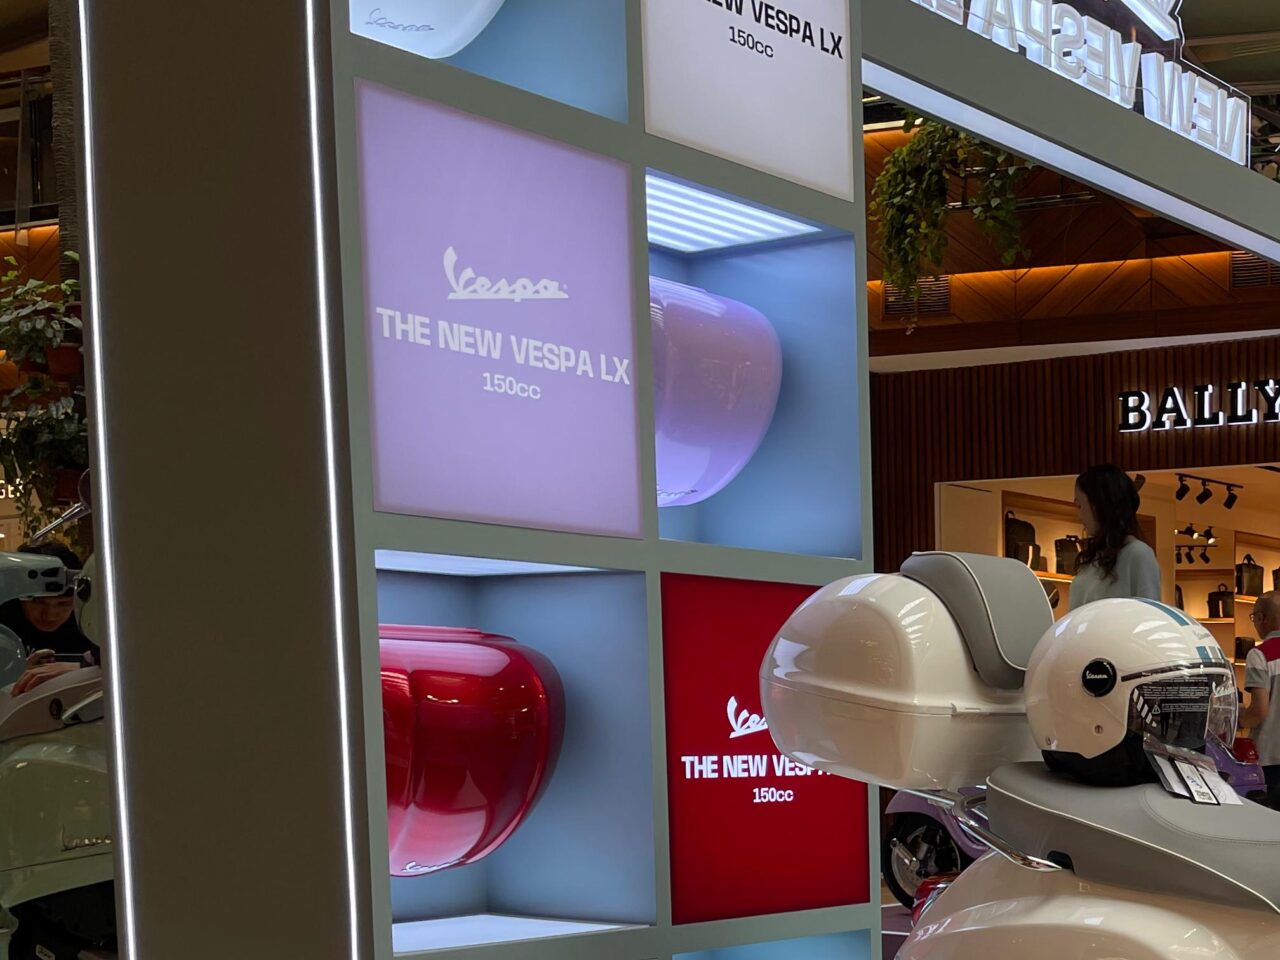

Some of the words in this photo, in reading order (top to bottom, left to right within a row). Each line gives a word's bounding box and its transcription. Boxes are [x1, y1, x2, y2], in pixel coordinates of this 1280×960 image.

[728, 26, 774, 58] 150cc
[751, 0, 815, 47] VESPA
[820, 27, 844, 59] LX
[443, 246, 569, 302] Vespa
[376, 307, 431, 346] THE
[437, 320, 502, 359] NEW
[510, 335, 594, 378] VESPA
[600, 353, 630, 385] LX
[482, 372, 541, 399] 150cc
[681, 755, 719, 779] THE
[722, 755, 768, 778] NEW
[752, 787, 794, 803] 150cc
